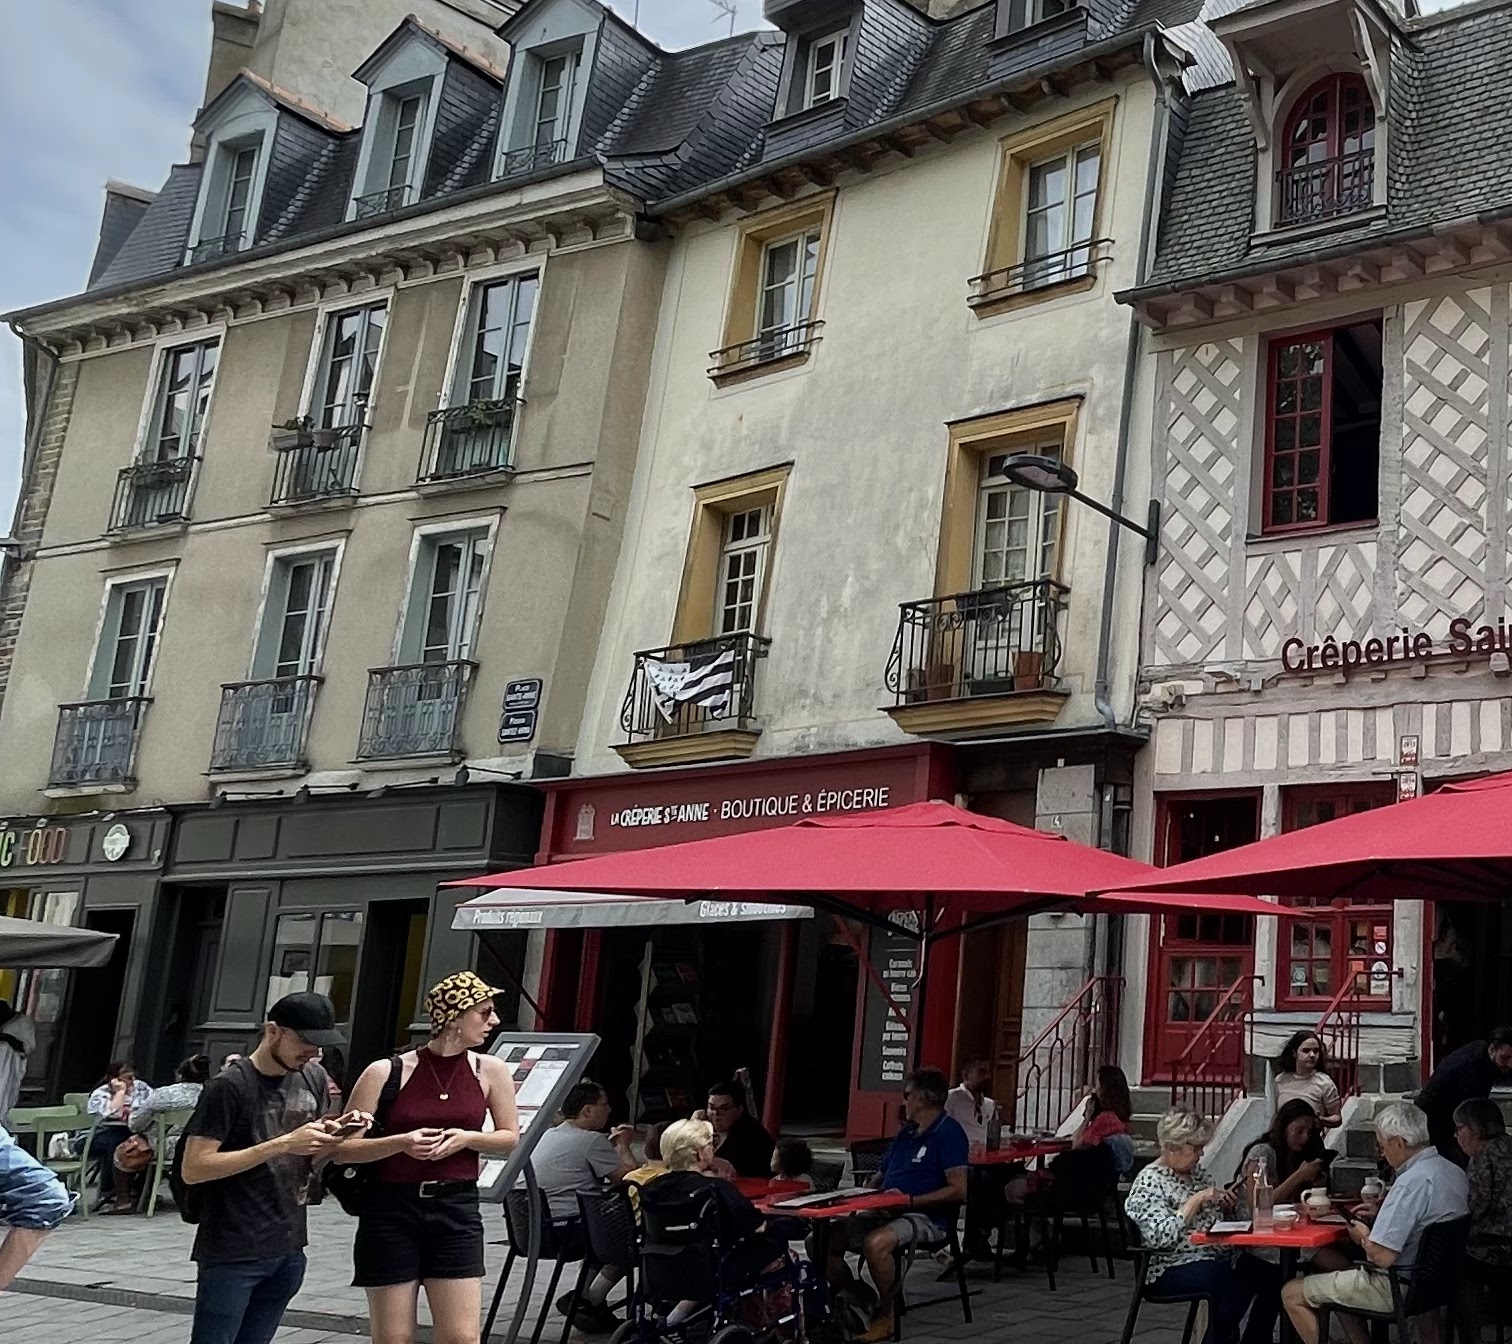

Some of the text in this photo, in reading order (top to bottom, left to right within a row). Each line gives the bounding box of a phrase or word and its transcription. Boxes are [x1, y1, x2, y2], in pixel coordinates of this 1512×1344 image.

[1282, 627, 1433, 682] Crêperie
[677, 803, 710, 822] ANNE
[720, 795, 799, 819] BOUTIQUE
[802, 794, 813, 813] &
[816, 788, 890, 812] ÉPICERIE
